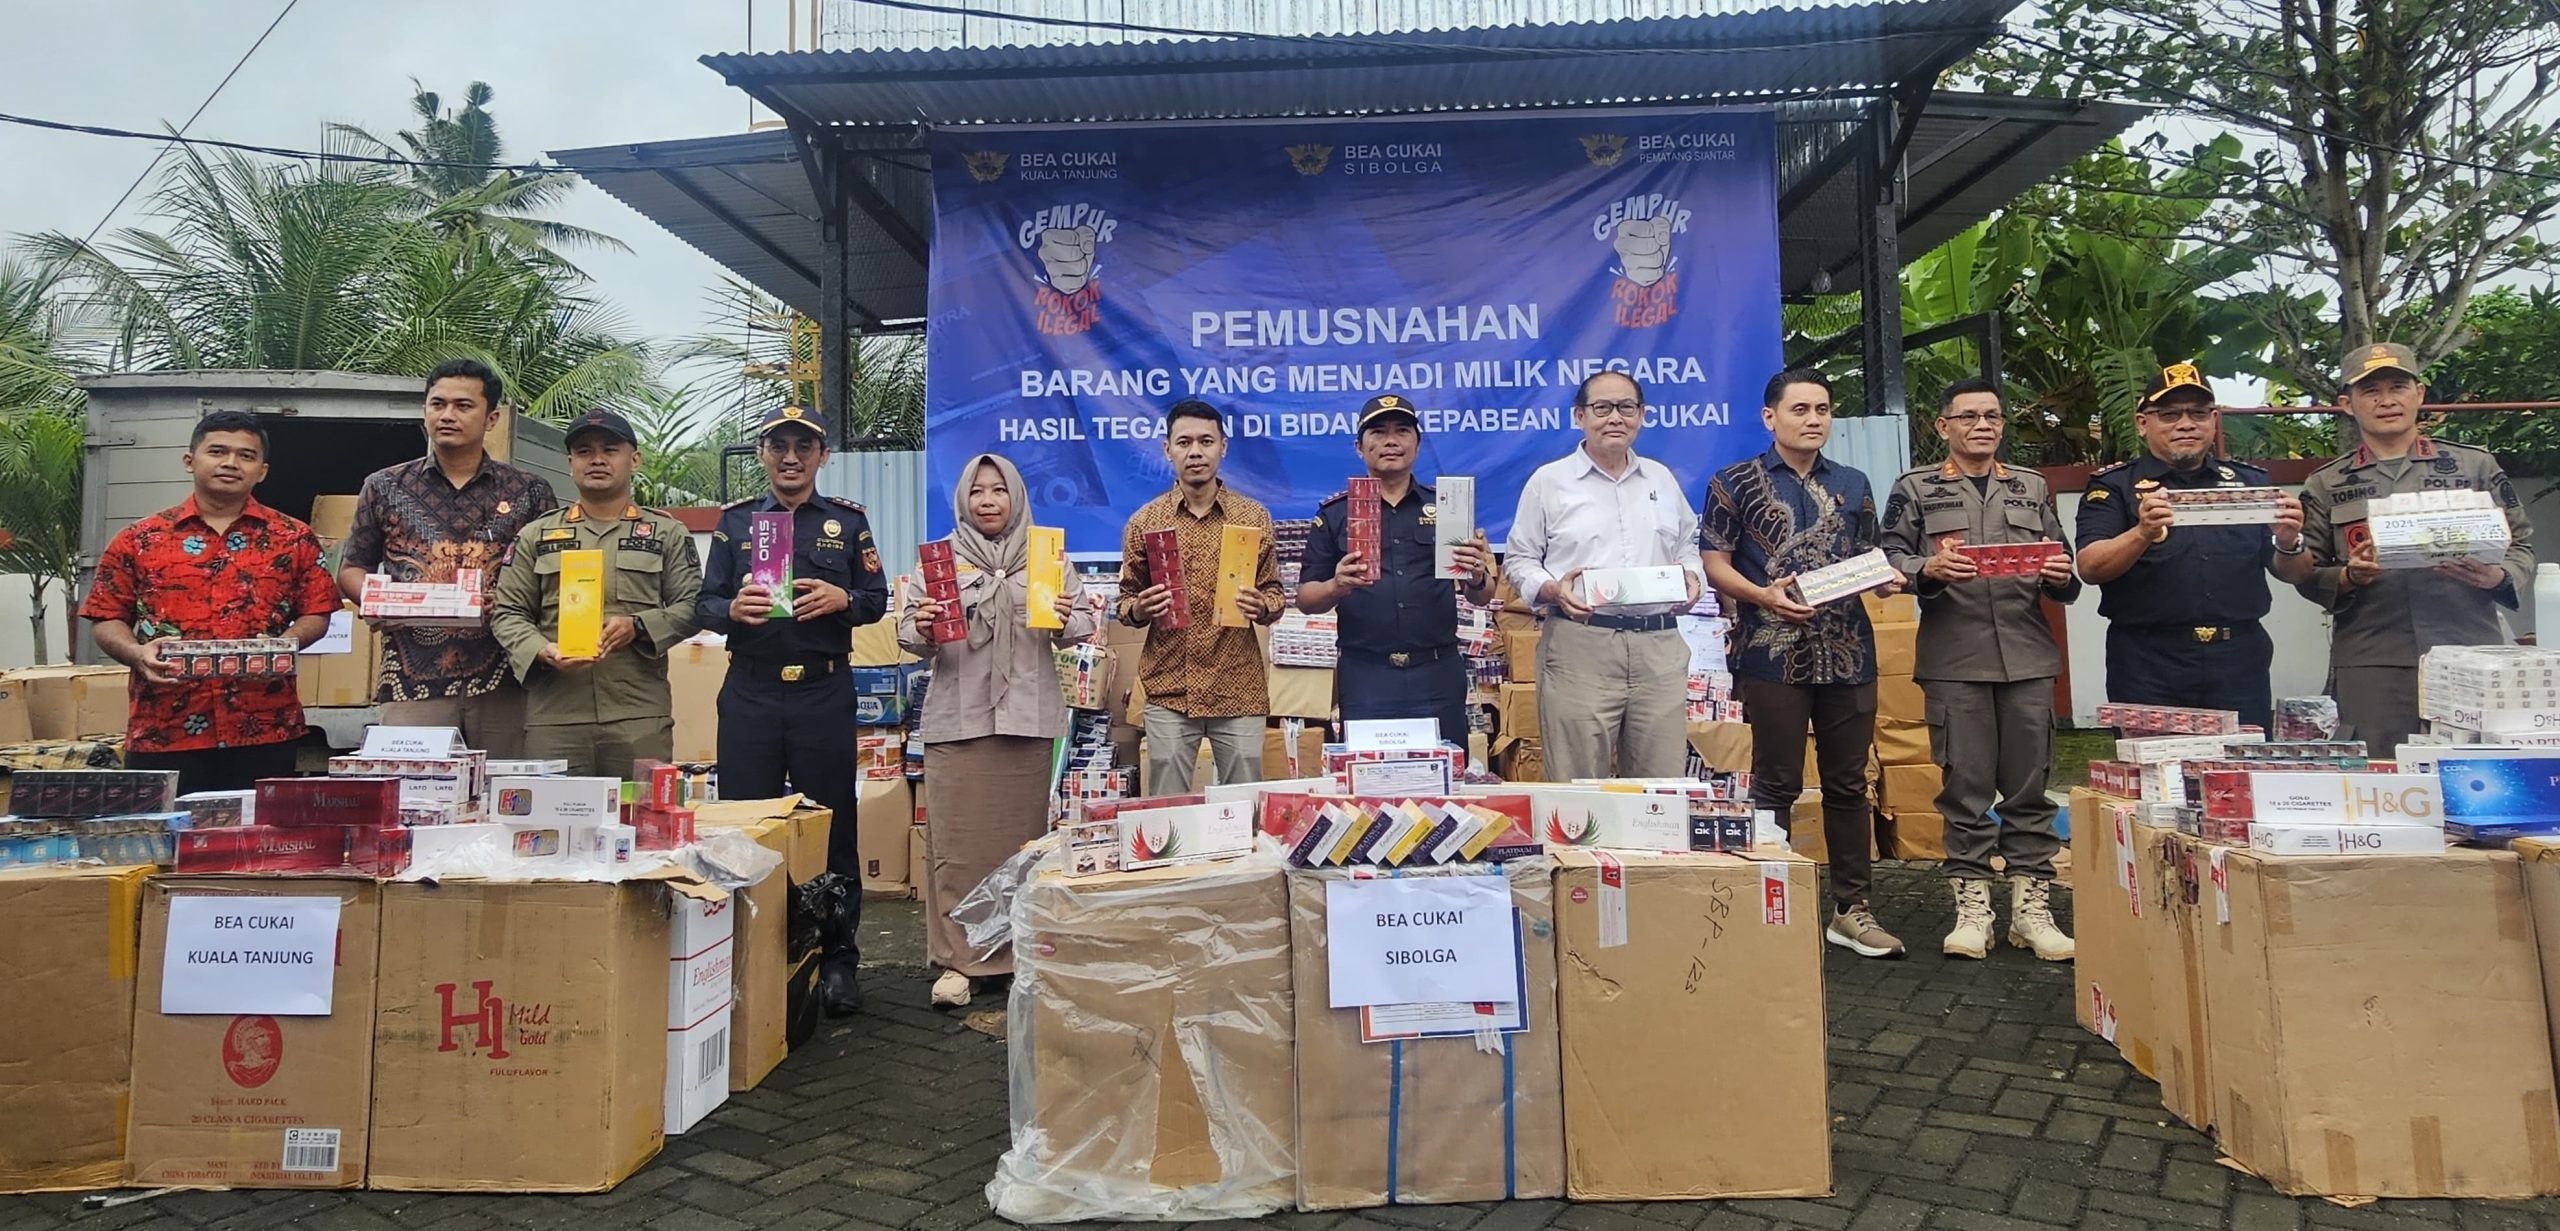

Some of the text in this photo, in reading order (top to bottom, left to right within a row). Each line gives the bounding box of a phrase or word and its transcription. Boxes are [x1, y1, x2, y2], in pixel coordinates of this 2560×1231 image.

[1638, 133, 1735, 150] BEA CUKAI
[1020, 151, 1117, 167] BEA CUKAI
[1344, 143, 1442, 159] BEA CUKAI
[1639, 149, 1736, 163] PEMATANG SIANTAR
[1020, 168, 1118, 181] KUALA TANJUNG
[1344, 161, 1443, 175] SIBOLGA
[1593, 193, 1692, 241] GEMPUR
[1019, 203, 1118, 249] GEMPUR
[1034, 280, 1102, 315] ROKOK
[1611, 272, 1680, 307] ROKOK
[1614, 295, 1680, 328] ILEGAL
[1036, 309, 1101, 337] ILEGAL
[1191, 303, 1540, 348] PEMUSNAHAN
[1021, 367, 1171, 398] BARANG
[1180, 365, 1277, 395] YANG
[1288, 361, 1443, 393] MENJADI
[1454, 359, 1548, 388] MILIK
[1000, 416, 1085, 442] HASIL
[1243, 413, 1271, 438] DI
[1641, 402, 1730, 428] CUKAI
[2423, 478, 2451, 489] POL
[2331, 486, 2377, 503] TOBING
[2003, 499, 2025, 508] POL
[758, 519, 770, 561] ORIS
[2355, 786, 2432, 818] H&G
[257, 837, 316, 854] MARSHAL
[2344, 832, 2382, 849] H&G
[214, 915, 295, 930] BEA CUKAI
[1376, 910, 1463, 928] BEA CUKAI
[187, 950, 314, 965] KUALA TANJUNG
[1385, 949, 1458, 965] SIBOLGA
[434, 979, 511, 1060] H1
[508, 1003, 552, 1026] Mild
[519, 1028, 547, 1046] Gold
[237, 1096, 263, 1106] HARD
[262, 1097, 288, 1106] PACK
[203, 1113, 234, 1124] CLASS
[243, 1114, 305, 1125] CIGARETTES
